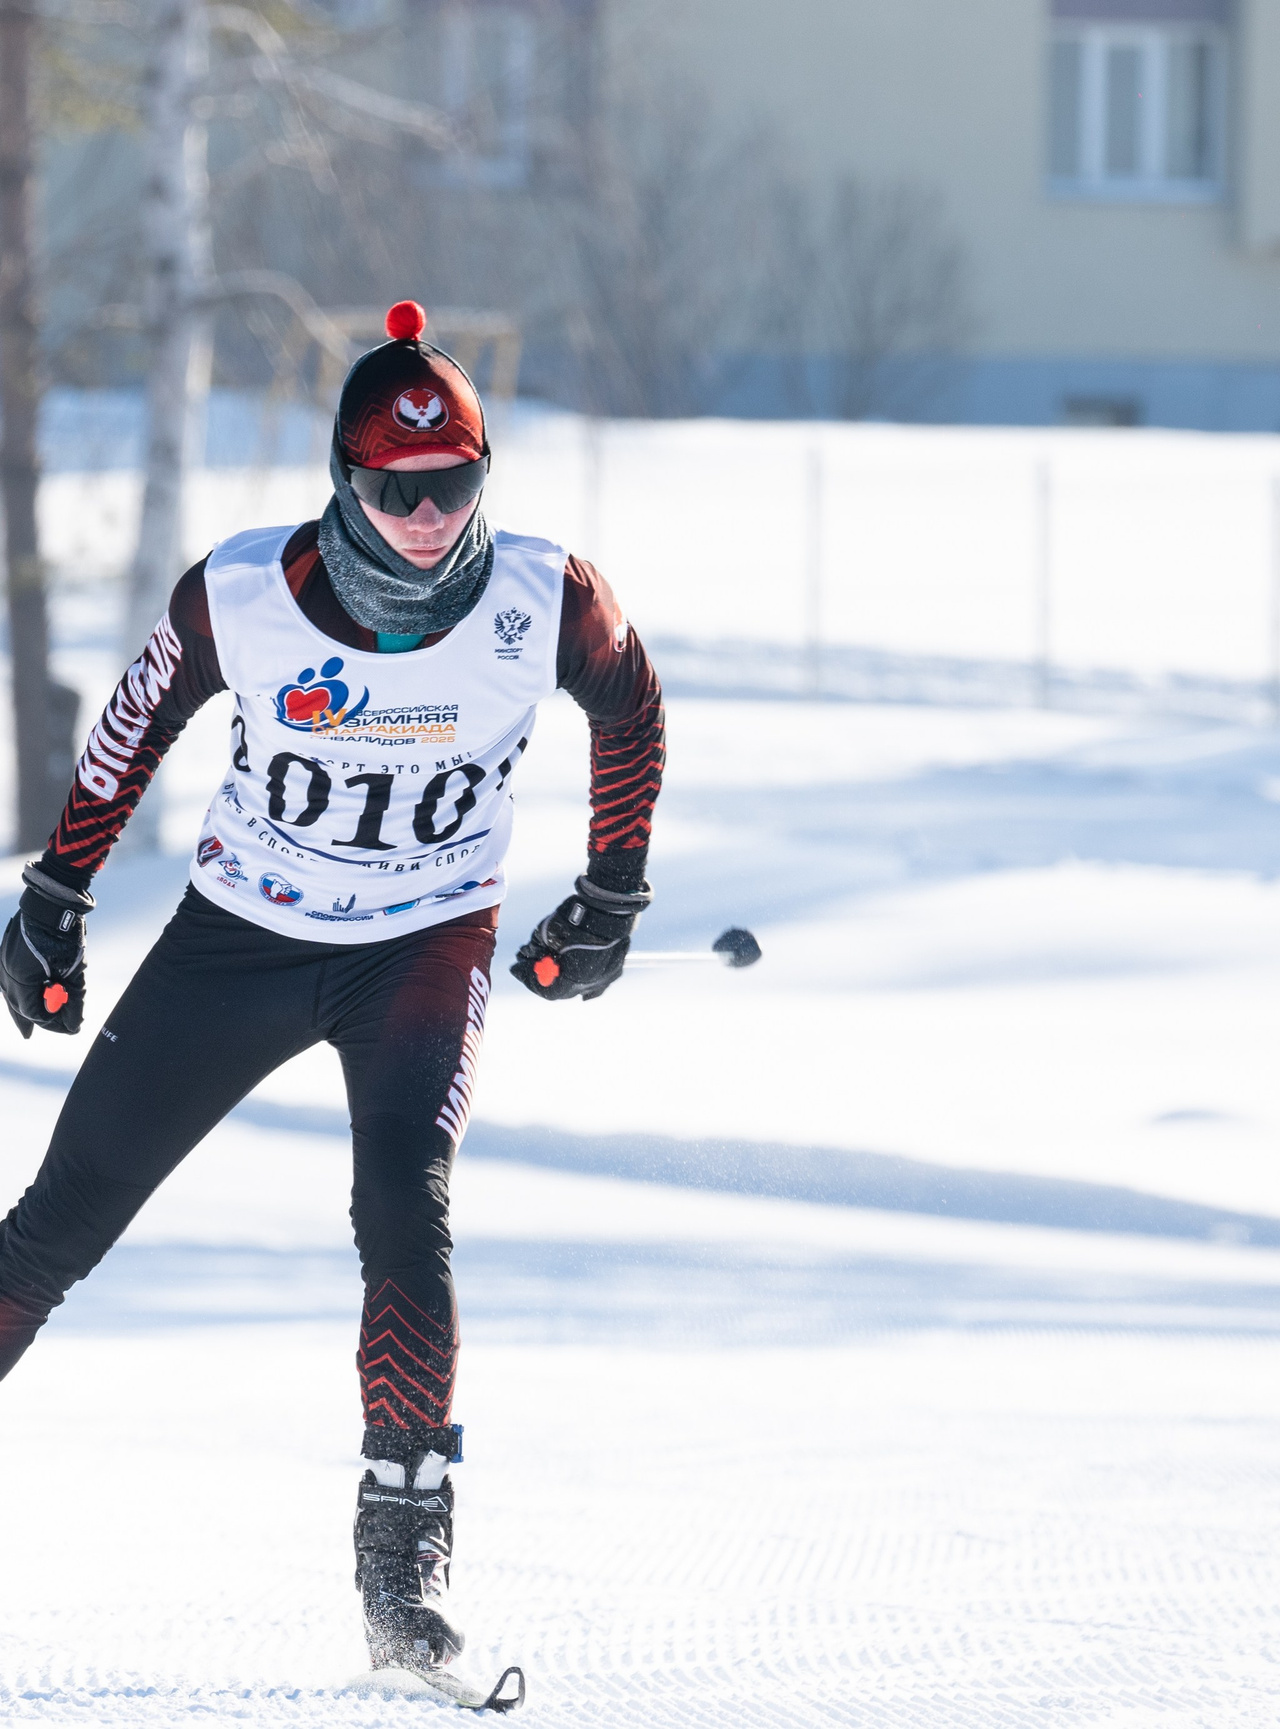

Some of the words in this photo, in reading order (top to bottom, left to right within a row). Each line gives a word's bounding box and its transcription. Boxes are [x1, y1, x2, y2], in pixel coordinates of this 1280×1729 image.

[312, 708, 347, 727] IV
[355, 704, 459, 717] ВСЕРОССИЙСКАЯ
[344, 712, 458, 728] ЗИМНЯЯ
[312, 724, 456, 736] СПАРТАКИАДА
[320, 735, 416, 746] НВАЛИДОВ
[381, 764, 420, 774] ЭТО
[362, 1493, 439, 1508] SPINE
